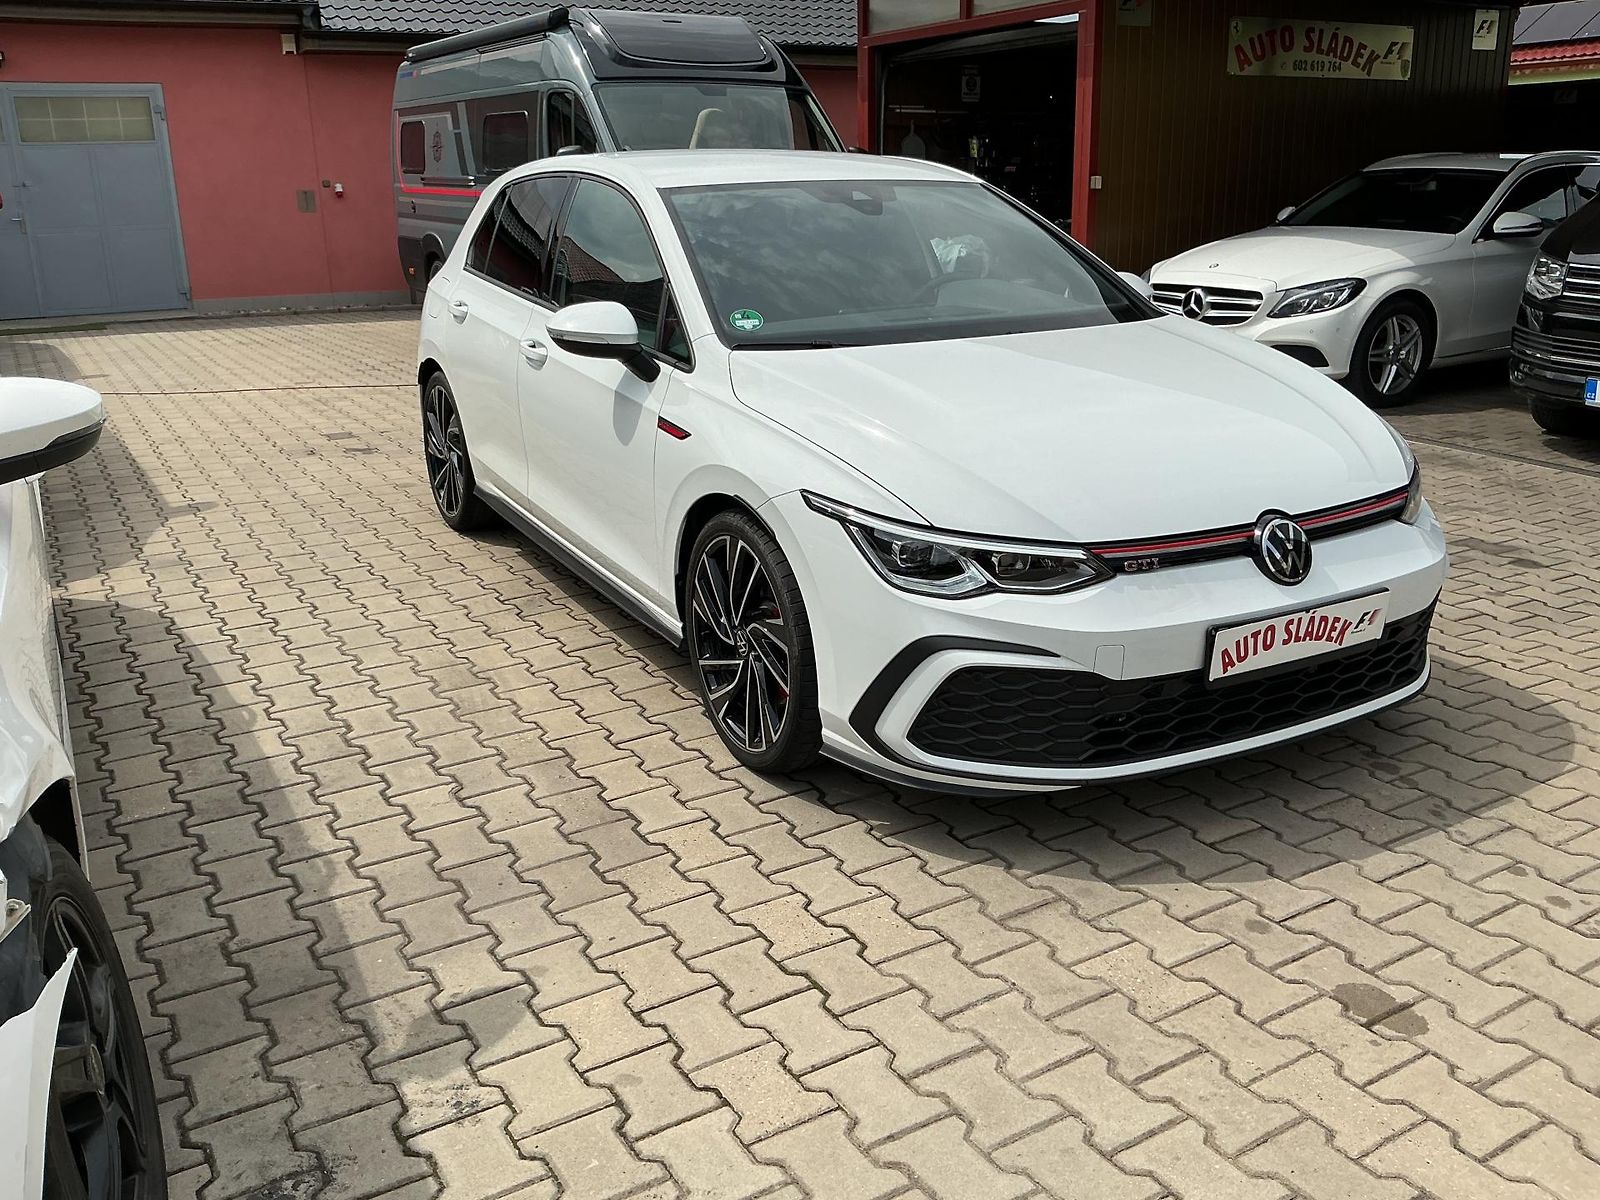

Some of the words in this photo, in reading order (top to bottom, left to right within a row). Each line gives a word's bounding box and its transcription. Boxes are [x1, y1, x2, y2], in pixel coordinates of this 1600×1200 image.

[1234, 25, 1295, 73] AUTO
[1303, 26, 1380, 77] SLÁDEK
[1292, 59, 1307, 72] 602
[1310, 59, 1325, 72] 619
[1327, 61, 1342, 73] 764
[1124, 558, 1160, 572] GTI
[1220, 623, 1276, 675] AUTO
[1282, 610, 1353, 646] SLÁDEK
